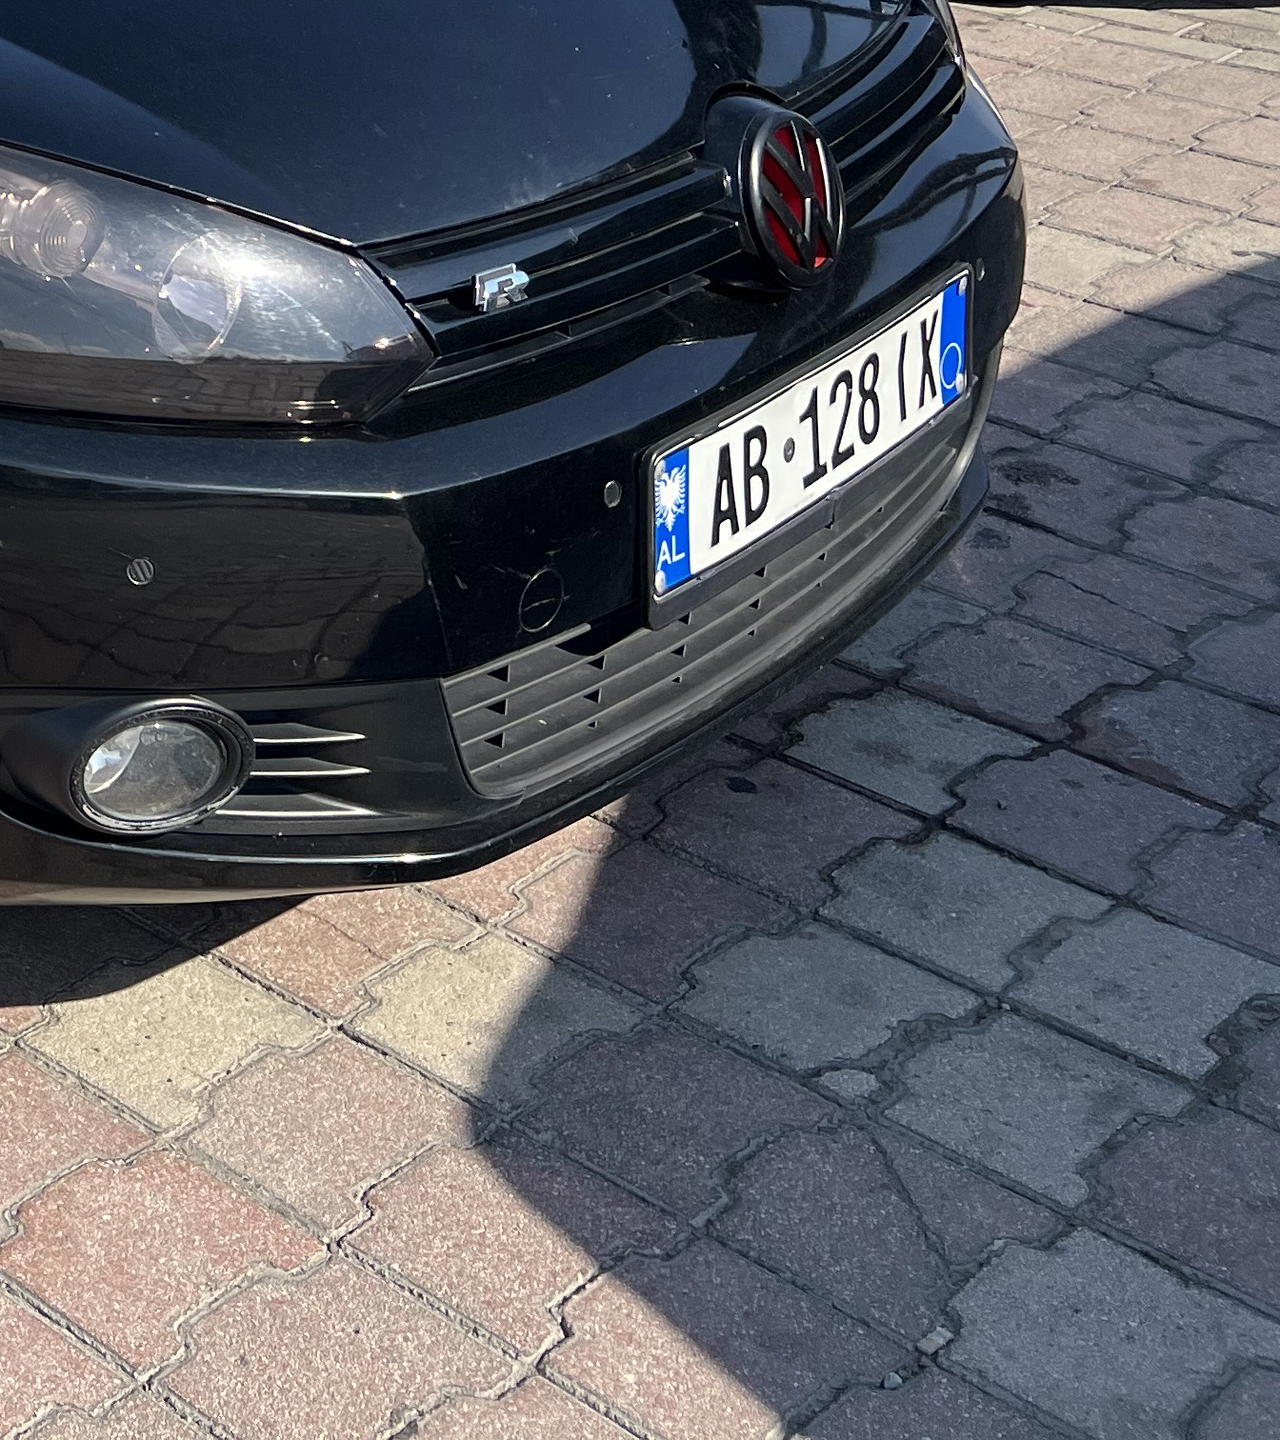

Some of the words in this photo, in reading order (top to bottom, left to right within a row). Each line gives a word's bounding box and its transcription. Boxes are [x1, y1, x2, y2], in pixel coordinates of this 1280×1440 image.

[473, 262, 531, 313] R
[710, 424, 770, 549] AB
[799, 352, 881, 490] 128
[656, 536, 686, 571] AL
